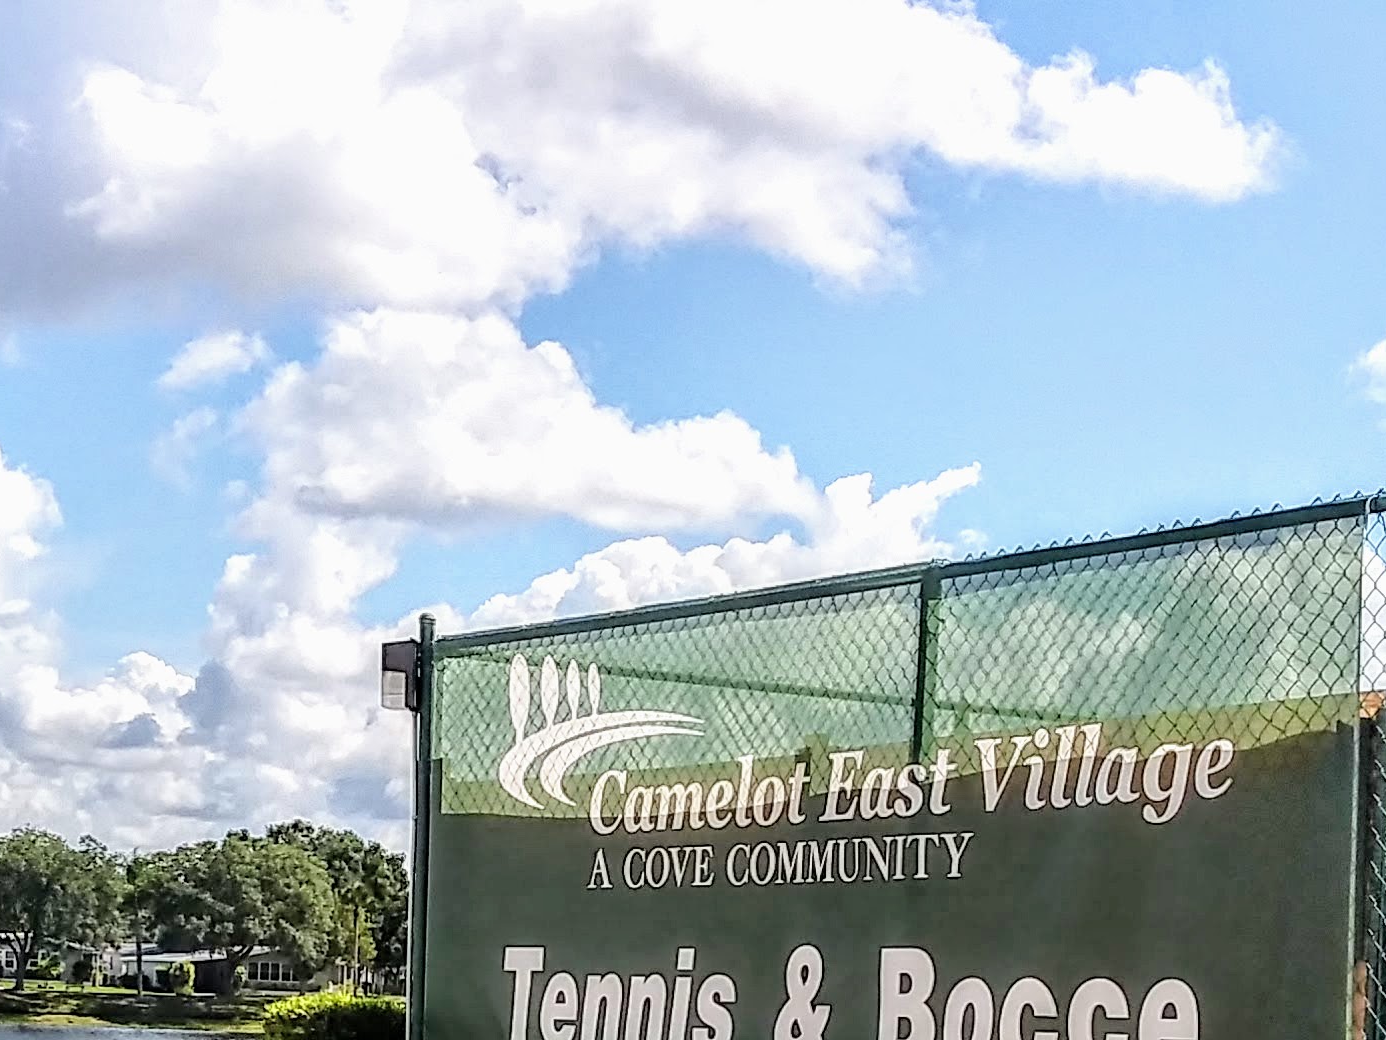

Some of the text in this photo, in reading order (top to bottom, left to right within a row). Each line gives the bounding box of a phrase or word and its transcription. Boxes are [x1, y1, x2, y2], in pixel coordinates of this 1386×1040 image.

[589, 723, 1234, 836] Camelot East Village
[586, 830, 974, 890] A COVE COMMUNITY
